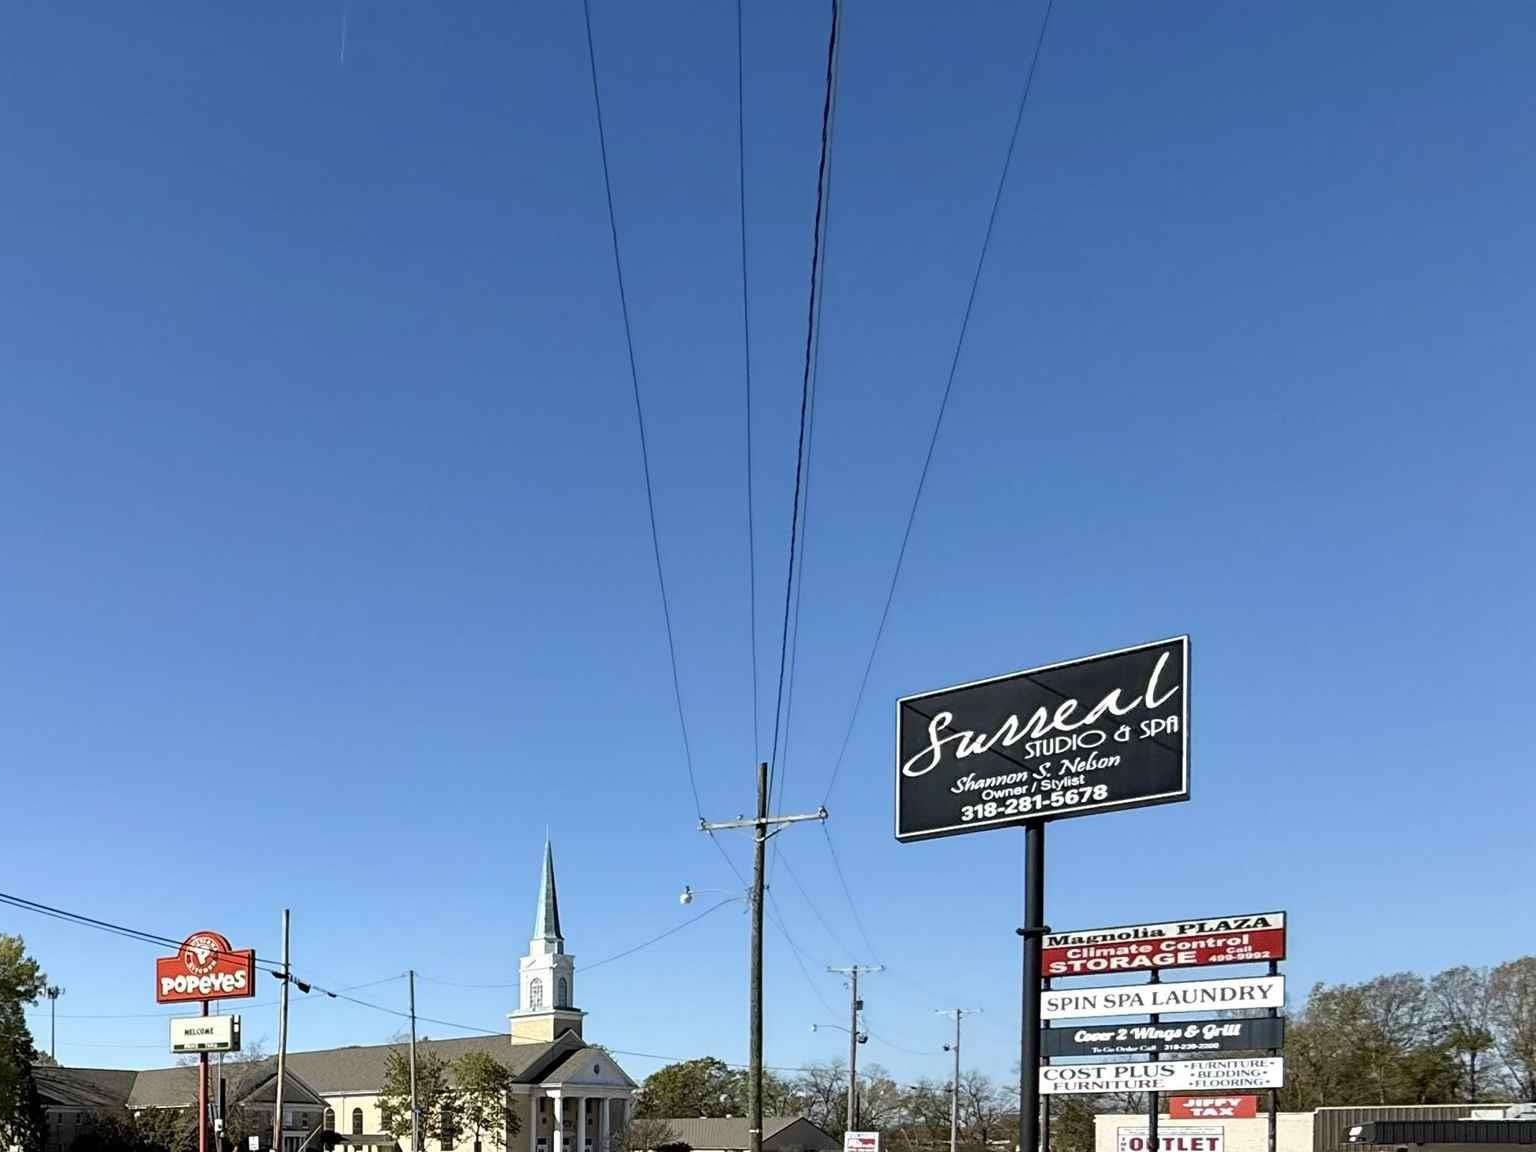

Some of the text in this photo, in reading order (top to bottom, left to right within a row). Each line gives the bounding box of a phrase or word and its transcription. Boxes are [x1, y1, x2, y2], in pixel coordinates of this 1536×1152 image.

[902, 651, 1179, 776] Surreal
[1024, 715, 1178, 759] STUDIO & SPA
[951, 751, 1121, 794] Shannon S. Nelson
[981, 784, 1029, 801] Owner
[1040, 774, 1086, 791] Stylist
[961, 785, 1108, 821] 318-281-5678
[1047, 917, 1272, 946] Magnolia PLAZA
[1066, 935, 1249, 959] Climate Control
[1226, 945, 1252, 954] Call
[1049, 951, 1197, 974] STORAGE
[1046, 984, 1274, 1012] SPIN SPA LAUNDRY
[184, 1028, 214, 1036] WELCOME
[1074, 1024, 1242, 1043] Cover 2 Wings & Grill
[1043, 1064, 1175, 1081] COST PLUS
[1191, 1060, 1269, 1070] FURNITURE
[1197, 1069, 1261, 1079] BEDDING
[1053, 1079, 1165, 1092] FURNITURE
[1194, 1078, 1263, 1088] FLOORING
[1182, 1098, 1242, 1107] JIFFY
[1190, 1107, 1234, 1116] TAX
